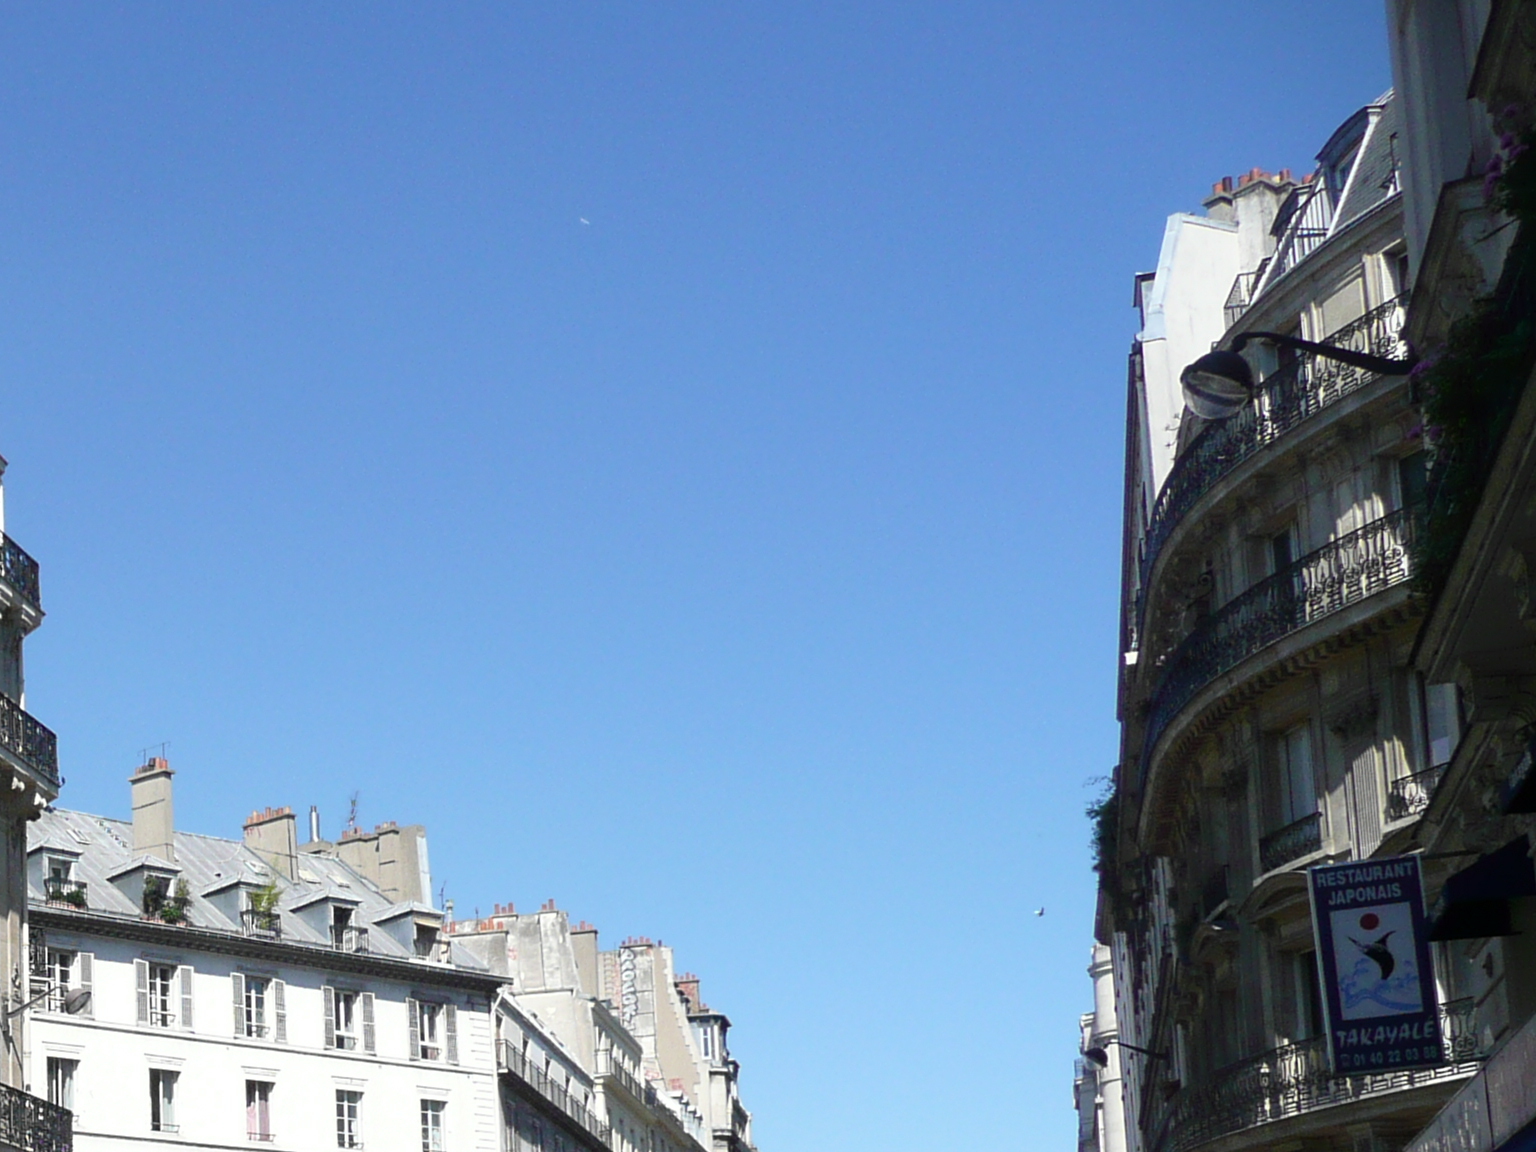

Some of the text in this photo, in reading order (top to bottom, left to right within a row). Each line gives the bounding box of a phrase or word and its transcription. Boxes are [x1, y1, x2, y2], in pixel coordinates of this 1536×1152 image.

[1316, 861, 1414, 888] RESTAURANT
[1328, 882, 1402, 906] JAPONAIS
[1335, 1015, 1435, 1049] TAKAYALÉ
